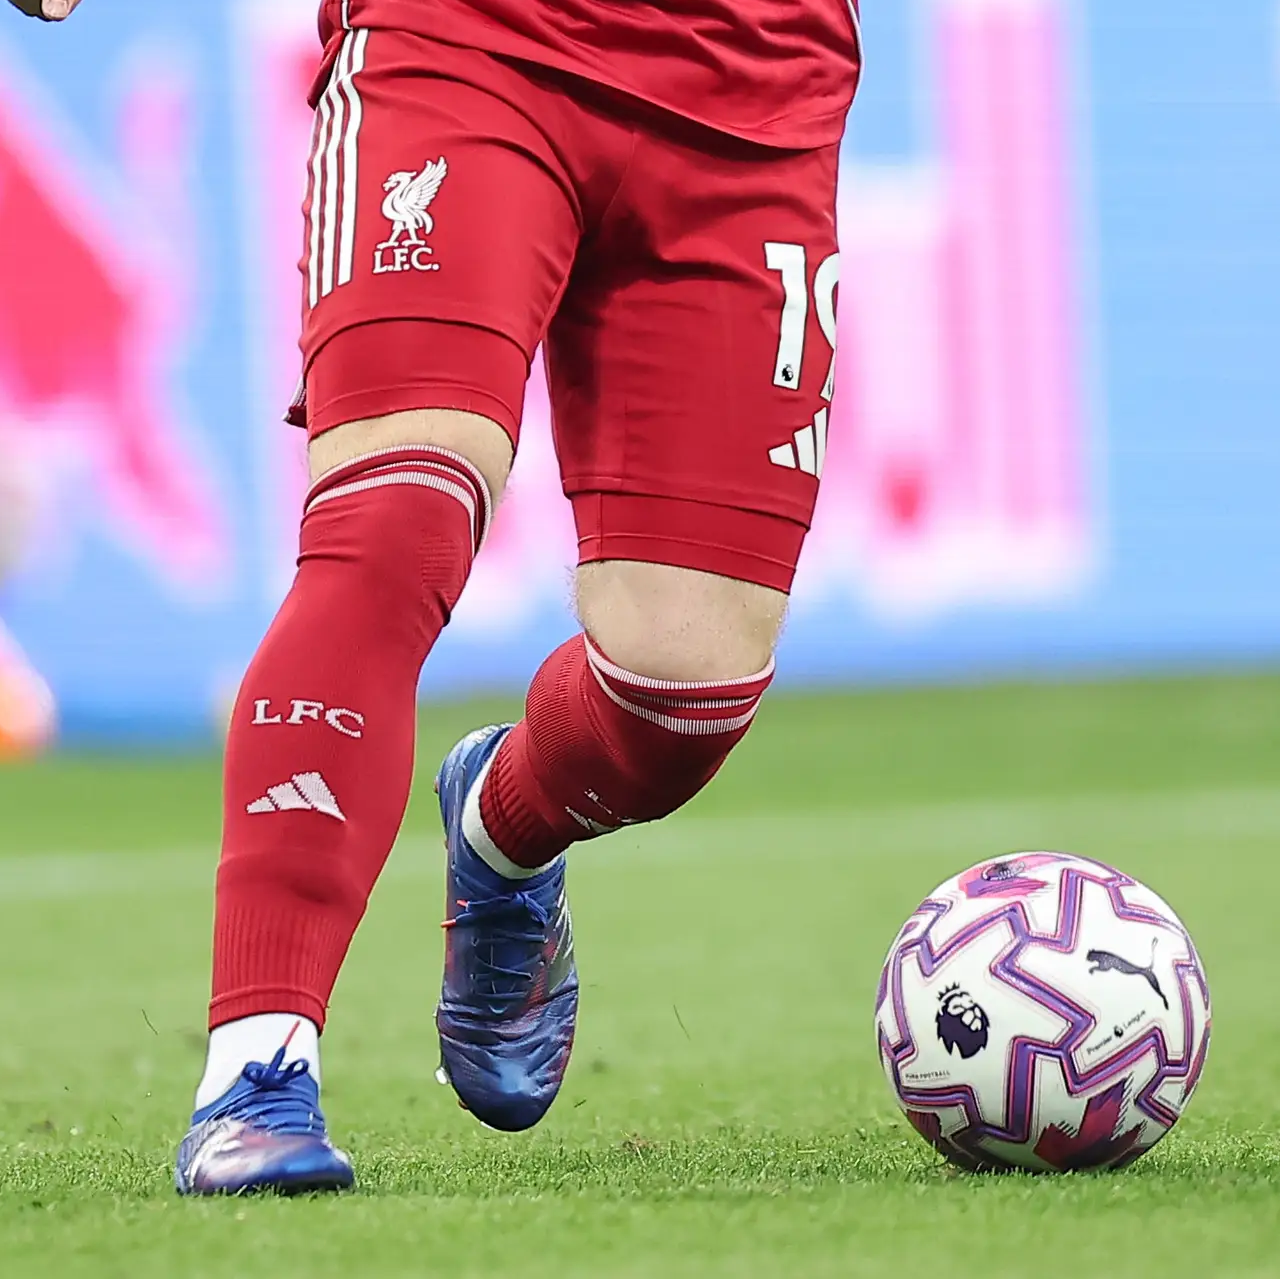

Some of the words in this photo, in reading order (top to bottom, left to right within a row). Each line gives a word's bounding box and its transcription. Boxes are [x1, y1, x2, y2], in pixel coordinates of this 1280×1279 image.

[373, 247, 440, 274] L.F.C.
[252, 699, 365, 738] LFC
[1086, 1035, 1112, 1055] Premier
